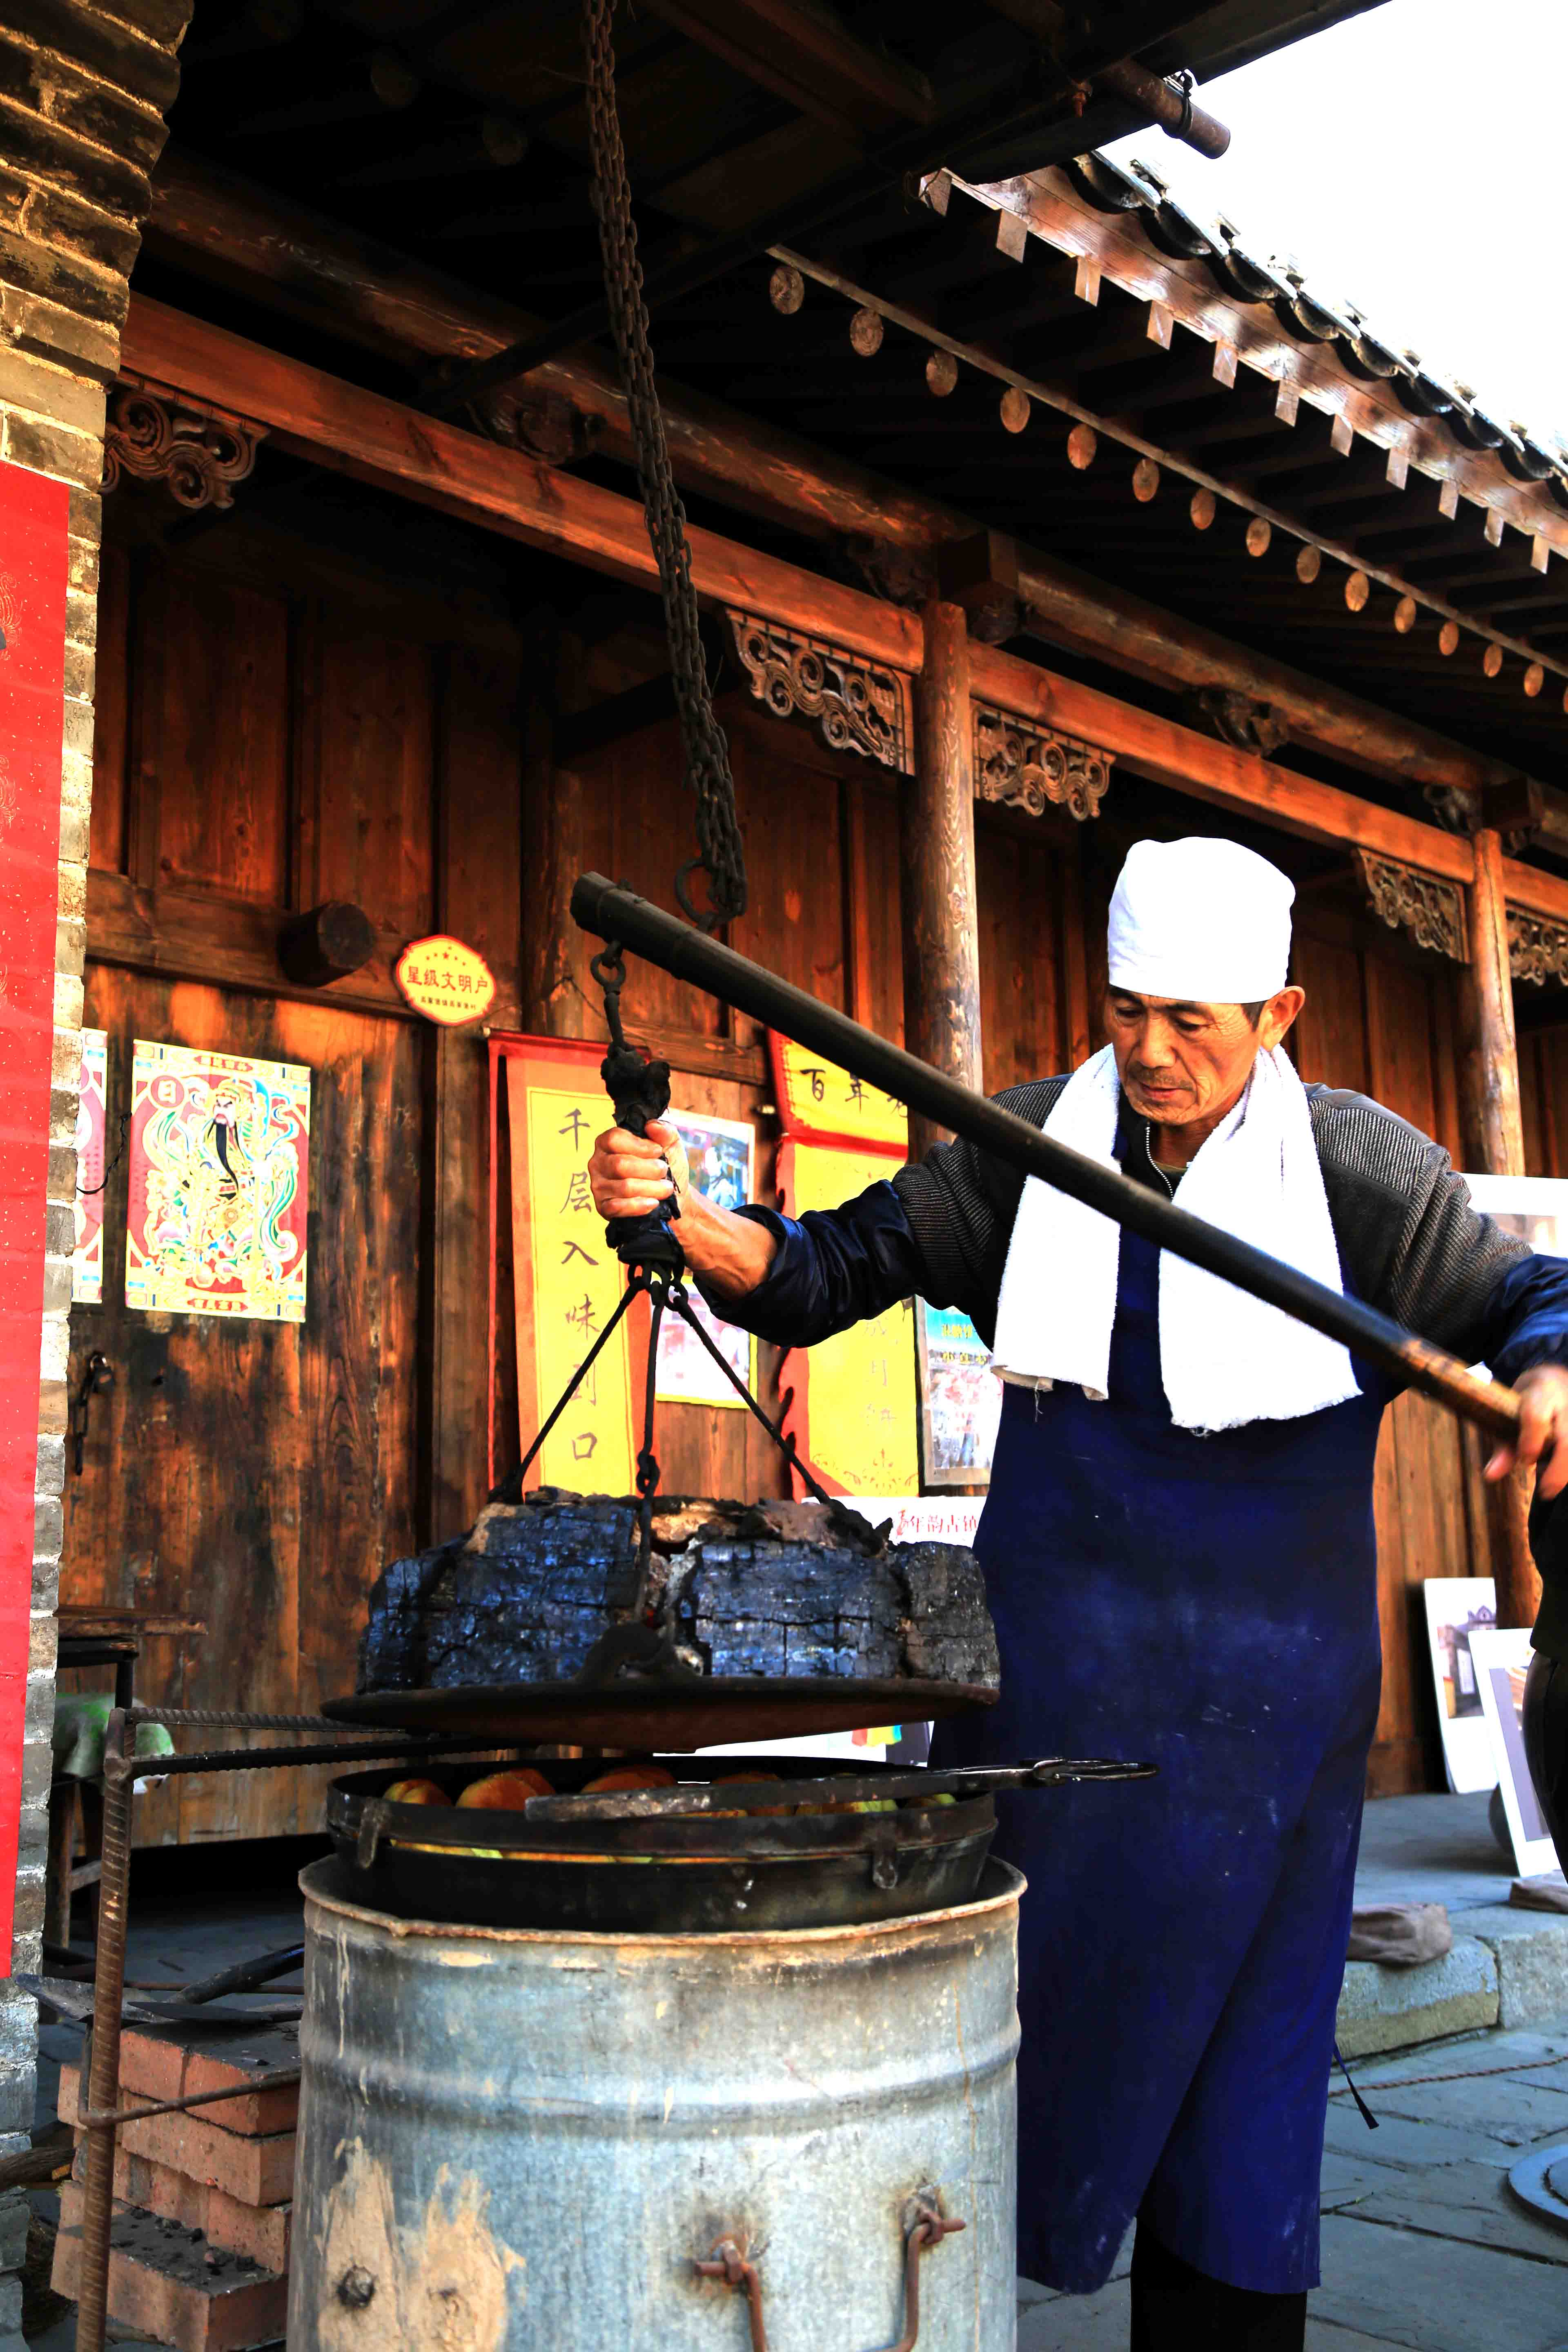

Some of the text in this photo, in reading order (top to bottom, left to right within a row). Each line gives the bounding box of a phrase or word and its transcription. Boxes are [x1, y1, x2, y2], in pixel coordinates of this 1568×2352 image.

[407, 965, 488, 993] 星级文明户
[558, 1108, 600, 1461] 千层入味到口
